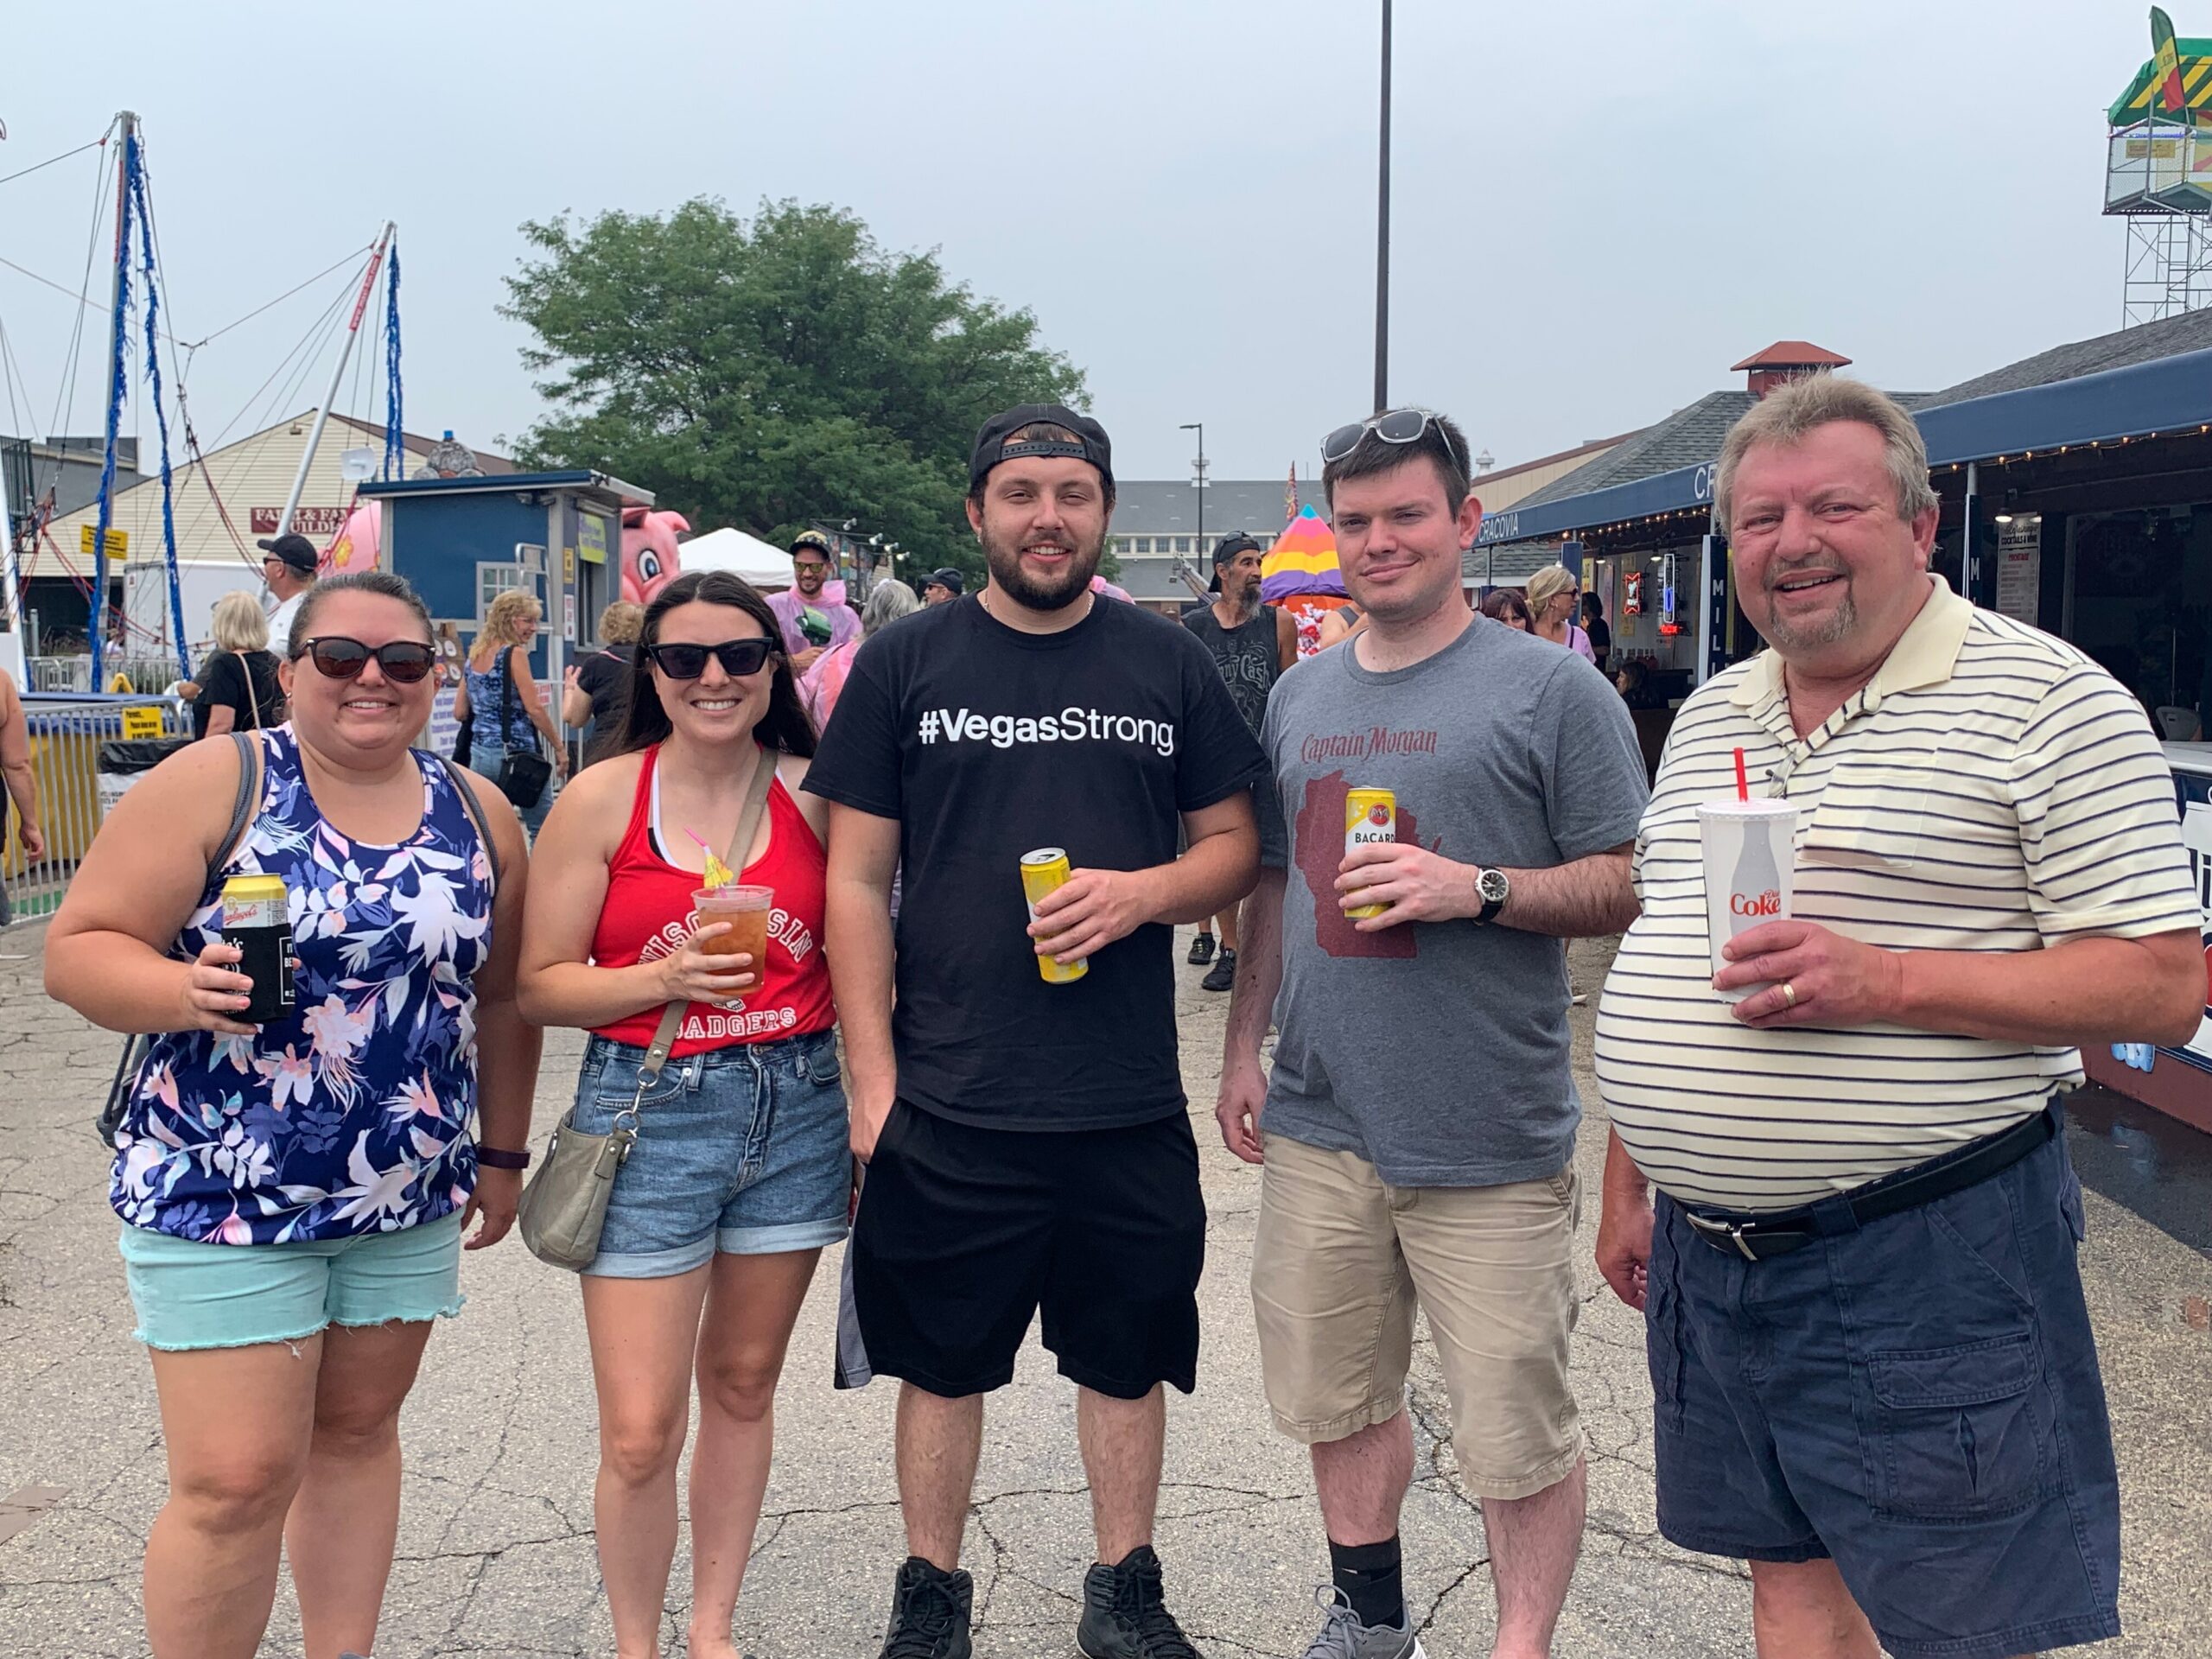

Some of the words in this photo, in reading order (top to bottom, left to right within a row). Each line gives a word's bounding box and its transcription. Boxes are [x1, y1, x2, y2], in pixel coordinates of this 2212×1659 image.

[289, 521, 340, 533] UILDI
[305, 509, 316, 520] &
[1478, 512, 1519, 543] CRACOVIA
[1240, 654, 1271, 693] Cash
[918, 707, 1173, 756] #VegasStrong
[1301, 731, 1365, 764] Captain
[1361, 727, 1437, 761] Morgan
[1730, 893, 1781, 916] Coke
[638, 908, 813, 964] WISCSIN
